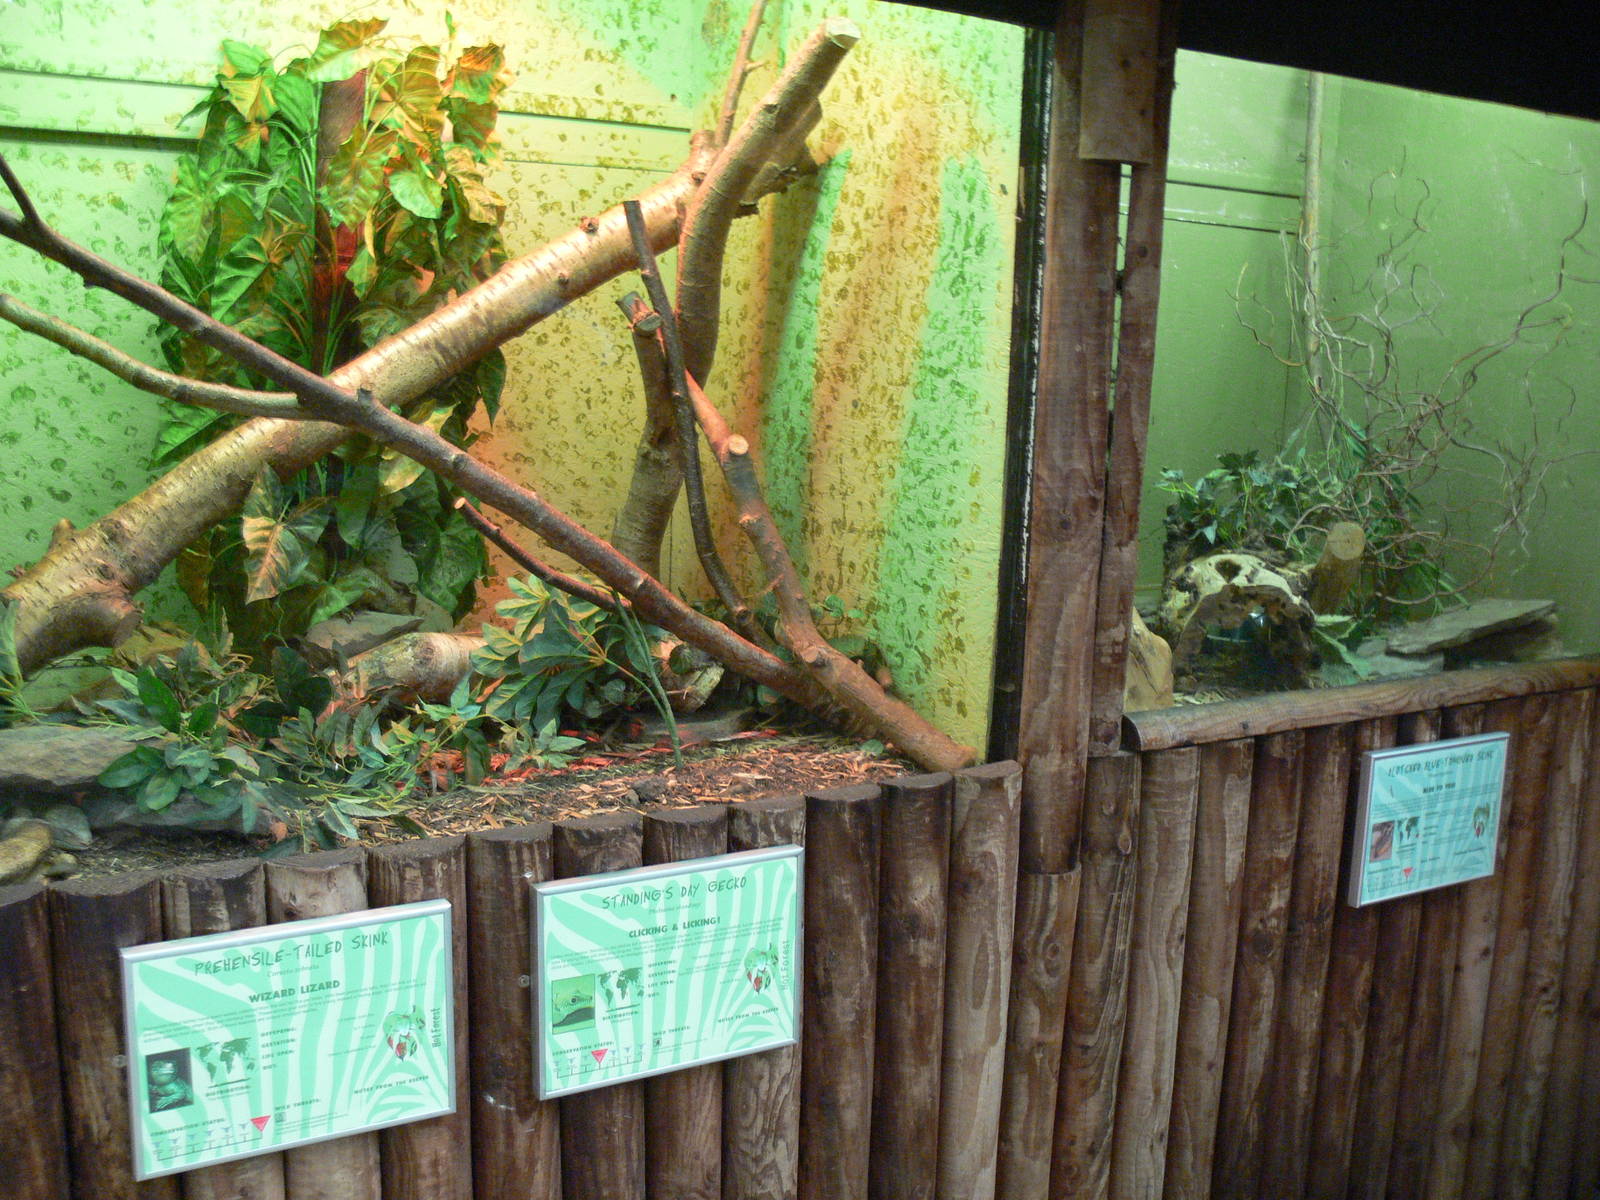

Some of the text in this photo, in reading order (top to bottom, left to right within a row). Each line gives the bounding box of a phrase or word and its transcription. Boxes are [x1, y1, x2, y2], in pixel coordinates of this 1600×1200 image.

[602, 886, 673, 910] STANDING'S
[681, 882, 700, 898] DAY
[707, 876, 747, 893] GECKO
[628, 925, 668, 938] CLICKING
[672, 923, 679, 931] &
[194, 940, 342, 977] PREHENSILE-TAILED
[352, 931, 388, 950] SKINK
[248, 988, 296, 1003] WIZARD
[300, 979, 341, 995] LIZARD
